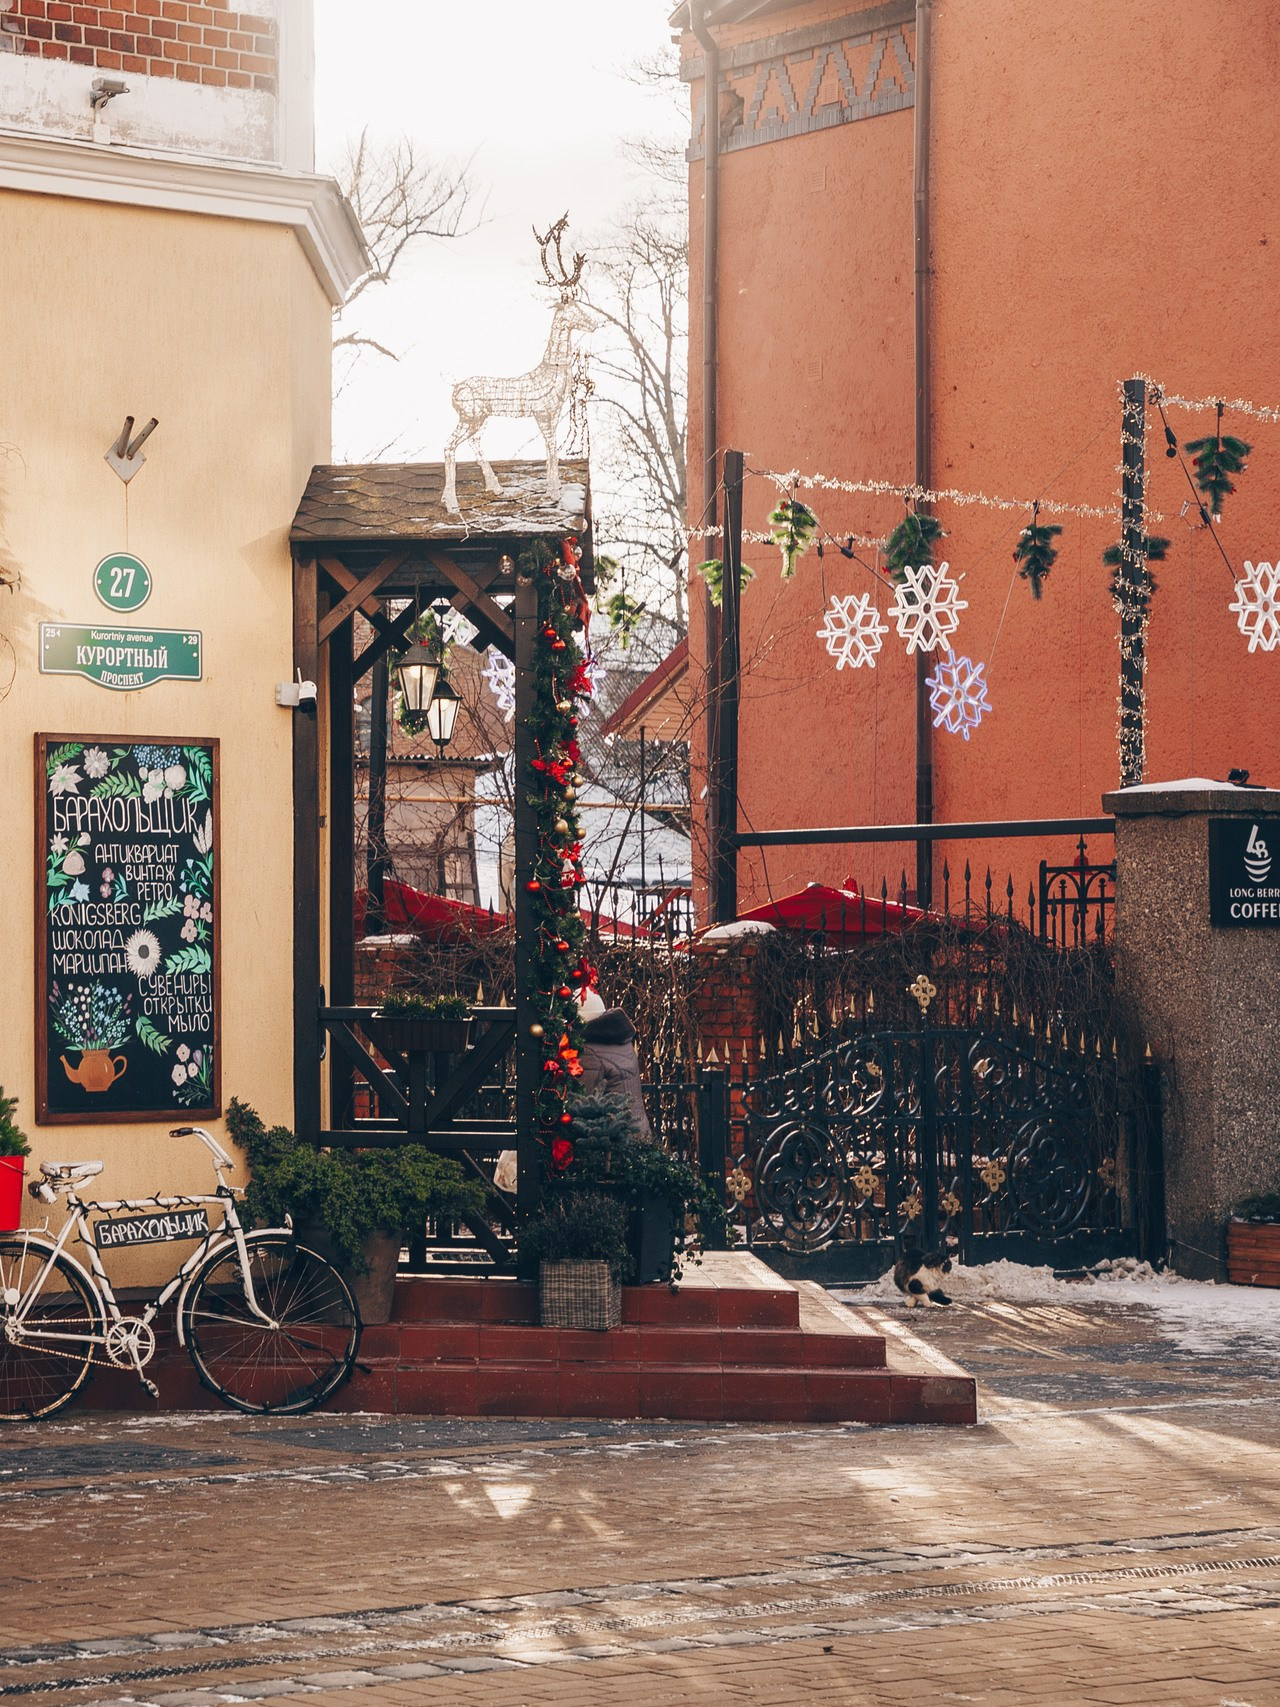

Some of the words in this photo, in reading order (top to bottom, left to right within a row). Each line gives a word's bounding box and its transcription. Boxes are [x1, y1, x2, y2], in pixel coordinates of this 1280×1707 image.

[110, 567, 135, 597] 27
[45, 628, 56, 637] 25
[91, 630, 125, 643] Kurortniy
[126, 633, 153, 643] avenue
[187, 635, 198, 645] 29
[76, 645, 168, 669] КУРОРТНЫЙ
[100, 670, 144, 686] ПРОСПЕКТ
[53, 796, 198, 838] БАРАХОЛЬЩИК
[95, 844, 180, 864] АНТИКВАРИАТ
[125, 864, 176, 881] ВИНТАЖ
[137, 882, 173, 901] РЕТРО
[1229, 888, 1255, 898] LONG
[51, 903, 142, 926] KONIGSBERG
[1230, 903, 1280, 918] COFFE
[52, 929, 125, 951] ШОКОЛАД
[52, 953, 129, 976] МАРЦИПАН
[138, 974, 212, 997] СУВЕНИРЫ
[143, 996, 212, 1015] ОТКРЫТКИ
[168, 1013, 210, 1033] МЫЛО
[98, 1211, 209, 1245] БАРАХОЛЬЩИК
